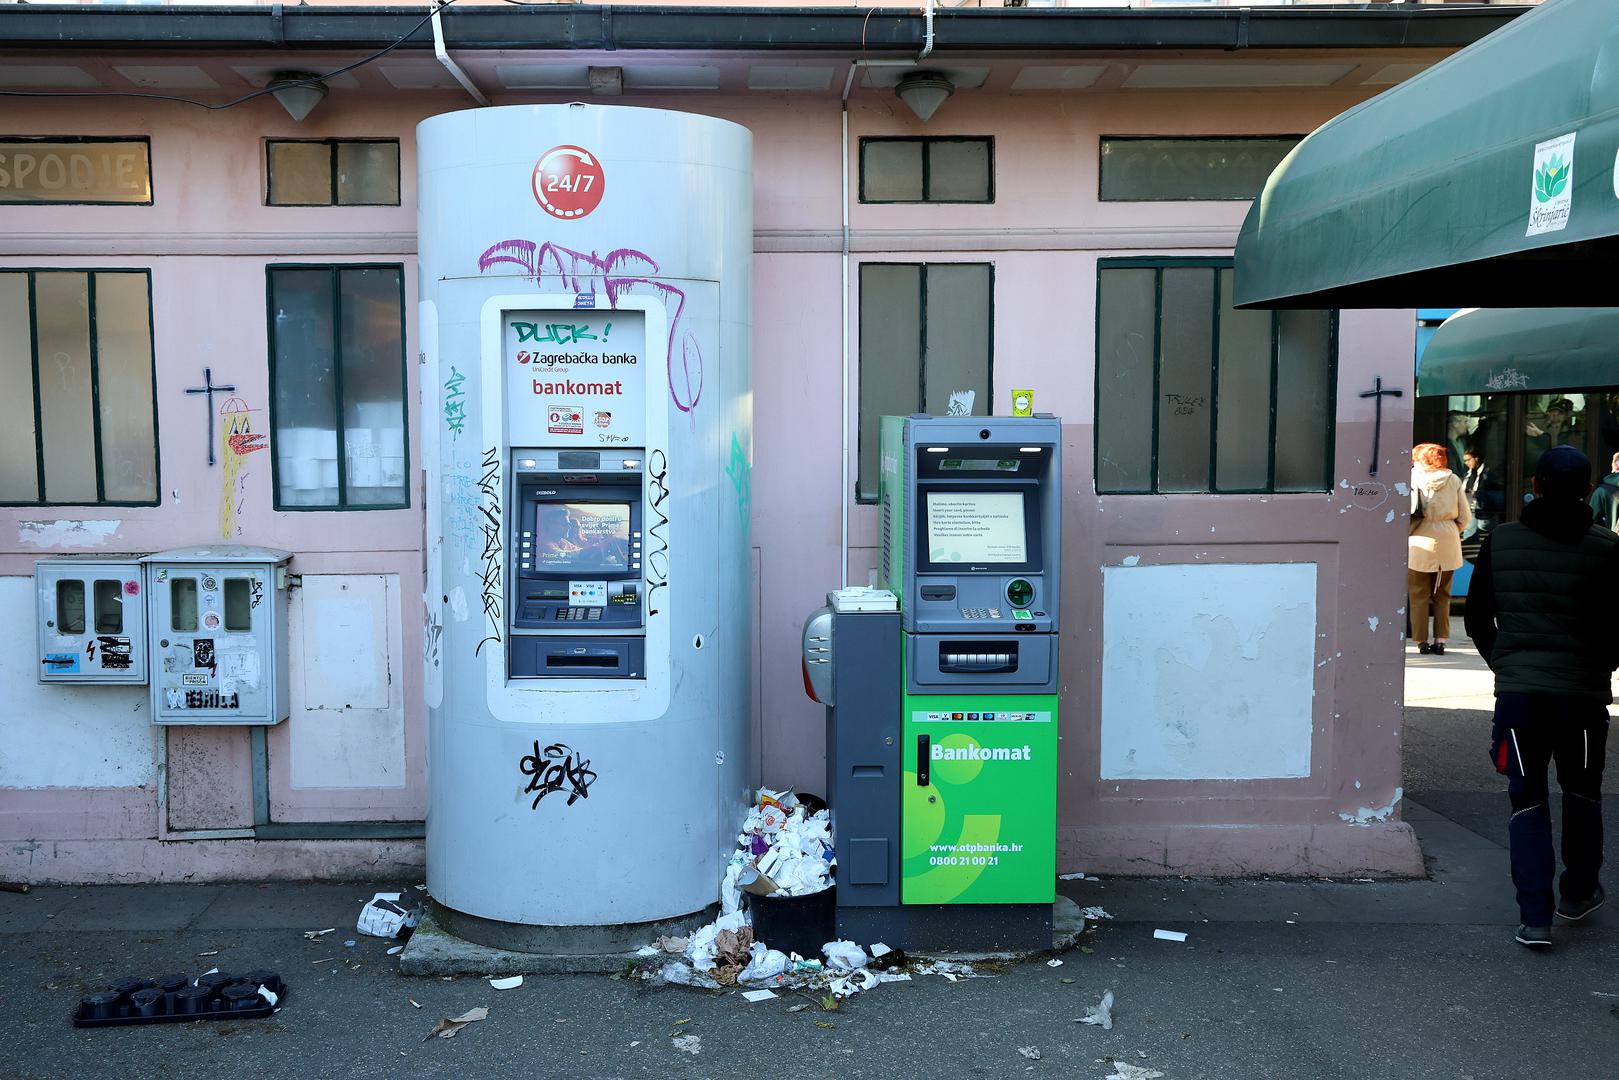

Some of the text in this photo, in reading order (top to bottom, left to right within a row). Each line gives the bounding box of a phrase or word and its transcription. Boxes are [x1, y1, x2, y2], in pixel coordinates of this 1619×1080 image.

[547, 174, 595, 192] 24/7
[532, 352, 637, 366] Zagrebačka banka
[532, 379, 622, 395] bankomat
[932, 743, 1031, 760] Bankomat
[929, 843, 1023, 854] www.otpbanka.hr
[929, 856, 999, 866] 0800 21 00 21
